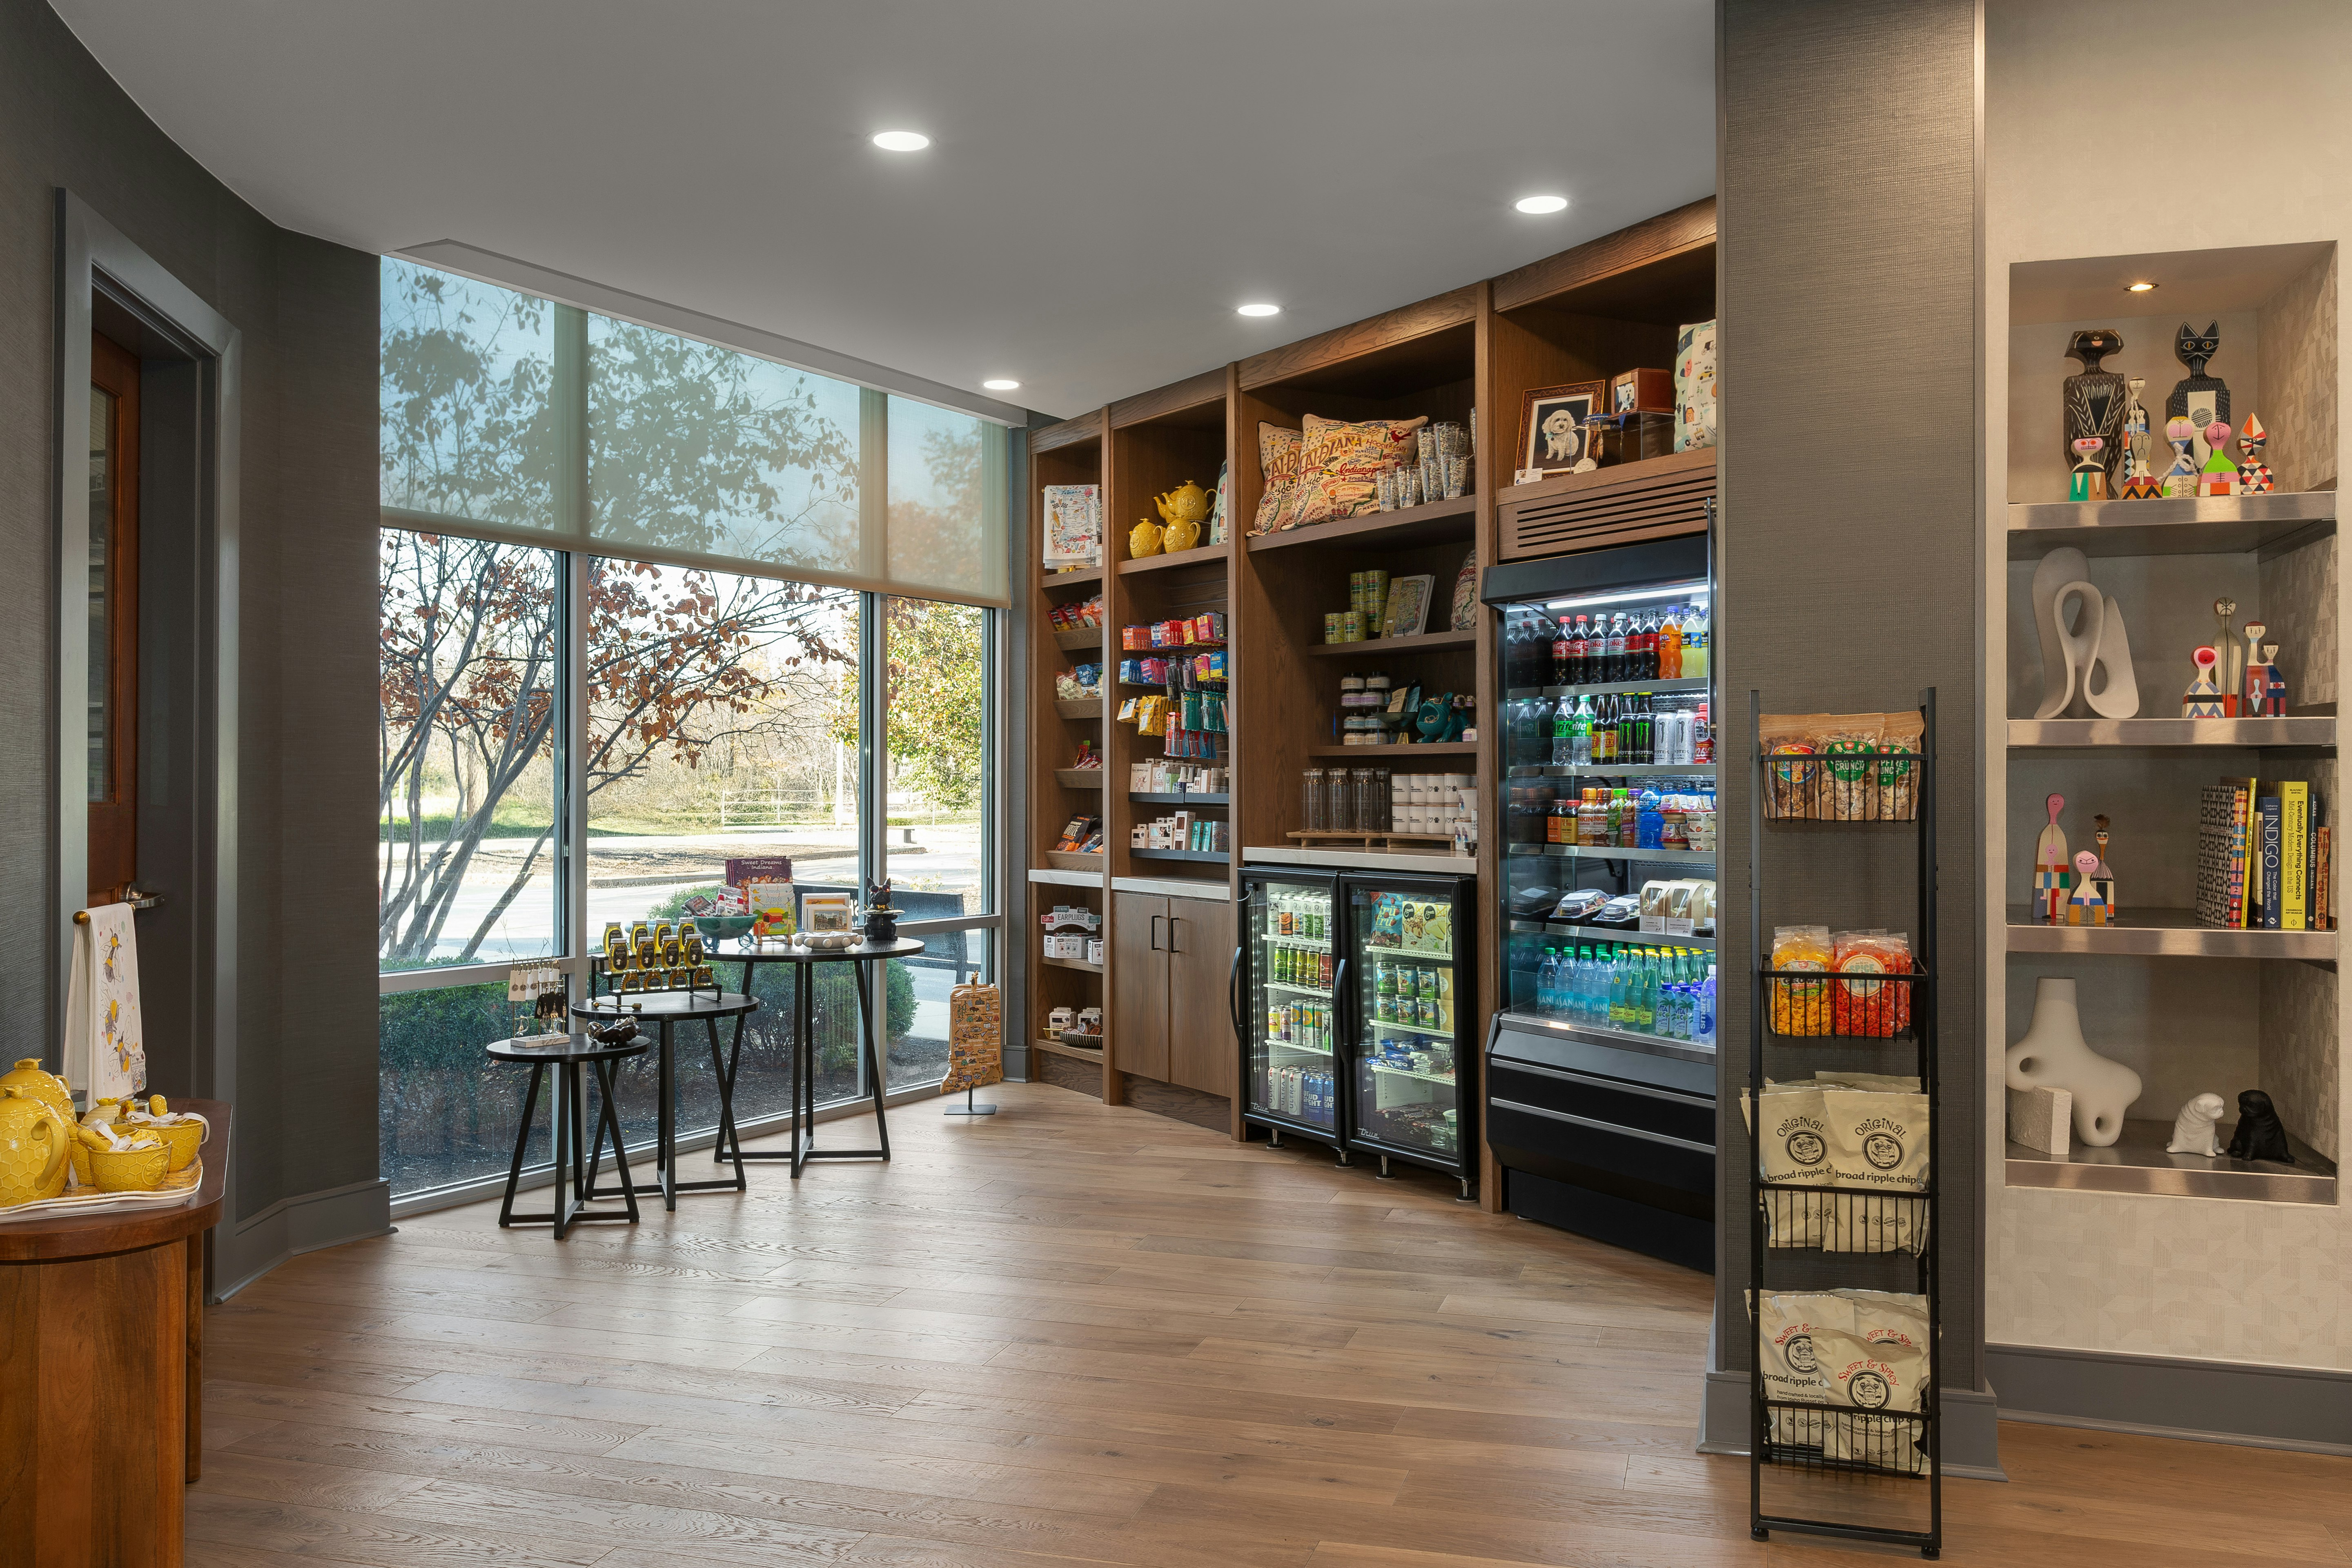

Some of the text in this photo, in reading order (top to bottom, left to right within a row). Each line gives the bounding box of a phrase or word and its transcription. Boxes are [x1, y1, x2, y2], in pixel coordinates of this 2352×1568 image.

[1366, 439, 1392, 449] HOOSIER
[1835, 762, 1864, 771] CRUNCH
[2265, 815, 2278, 868] INDIGO
[2295, 835, 2303, 869] Everything
[1379, 905, 1396, 916] trü
[1375, 915, 1394, 927] frü
[1849, 964, 1875, 973] SPICE
[1251, 1102, 1270, 1113] true
[1358, 1127, 1379, 1139] true
[1767, 1169, 1824, 1183] broad ripple
[1836, 1169, 1916, 1185] broad ripple chip
[1775, 1323, 1810, 1345] SWEET &
[1887, 1329, 1897, 1338] &
[1838, 1361, 1864, 1382] SWEET
[1866, 1359, 1878, 1369] &
[1763, 1371, 1817, 1388] broad ripple
[1853, 1414, 1881, 1424] ripple
